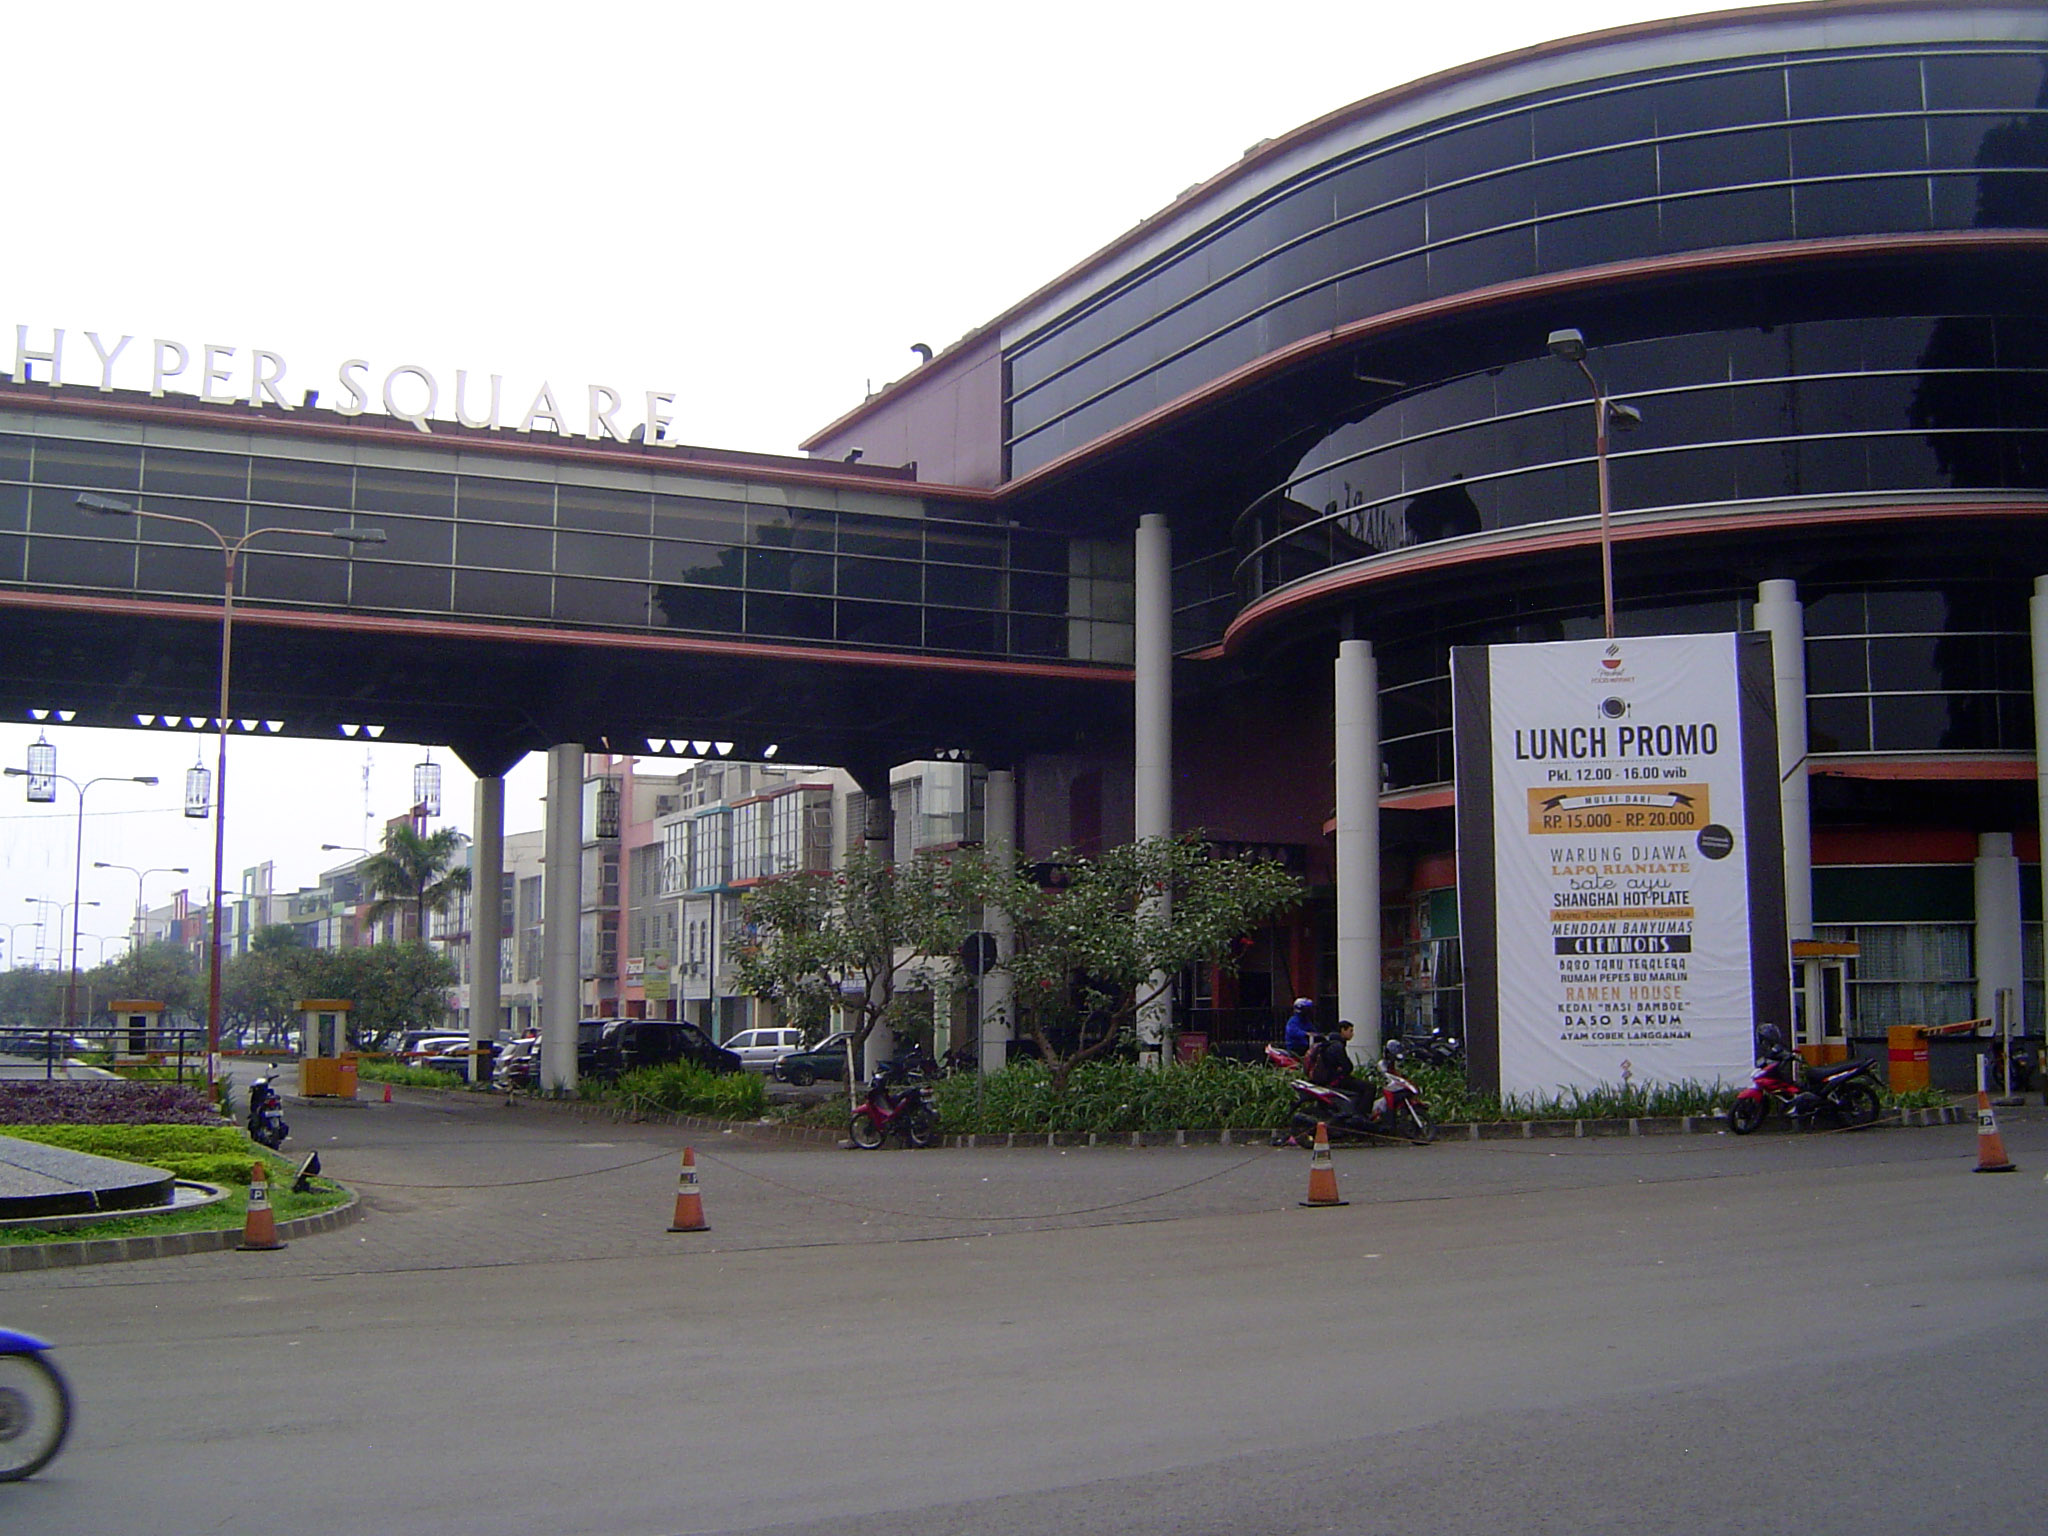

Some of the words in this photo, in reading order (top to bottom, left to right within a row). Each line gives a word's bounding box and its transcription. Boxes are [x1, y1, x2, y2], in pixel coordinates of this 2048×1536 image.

[12, 324, 294, 411] HYPER
[335, 358, 678, 447] SQUARE
[1515, 727, 1606, 760] LUNCH
[1619, 723, 1718, 757] PROMO
[1548, 769, 1572, 781] Pkl.
[1577, 768, 1611, 780] 12.00
[1624, 767, 1659, 779] 16.00
[1663, 766, 1687, 778] wib
[1585, 796, 1618, 804] MULAI
[1626, 795, 1651, 803] DARI
[1544, 814, 1562, 829] RP.
[1567, 814, 1611, 828] 15.000
[1626, 813, 1645, 826] RP.
[1650, 811, 1695, 826] 20.000
[1551, 847, 1622, 863] WARUNG
[1632, 846, 1687, 861] DJAWA
[1552, 865, 1597, 875] LAPO
[1570, 872, 1617, 890] sate
[1627, 878, 1672, 899] ayu
[1554, 892, 1618, 907] SHANGHAI
[1624, 891, 1647, 906] HOT
[1652, 891, 1690, 905] PLATE
[1552, 922, 1616, 935] MENDOAN
[1623, 920, 1693, 934] BANYUMAS
[1561, 973, 1596, 983] RUMAH
[1600, 973, 1630, 982] PEPES
[1634, 973, 1647, 981] BU
[1650, 972, 1687, 981] MARLIN
[1566, 986, 1620, 1001] RAMEN
[1630, 986, 1681, 1000] HOUSE
[1558, 1003, 1593, 1013] KEDAI
[1621, 1014, 1682, 1026] SAKUM
[1560, 1032, 1588, 1041] AYAM
[1628, 1031, 1692, 1040] LANGGANAN
